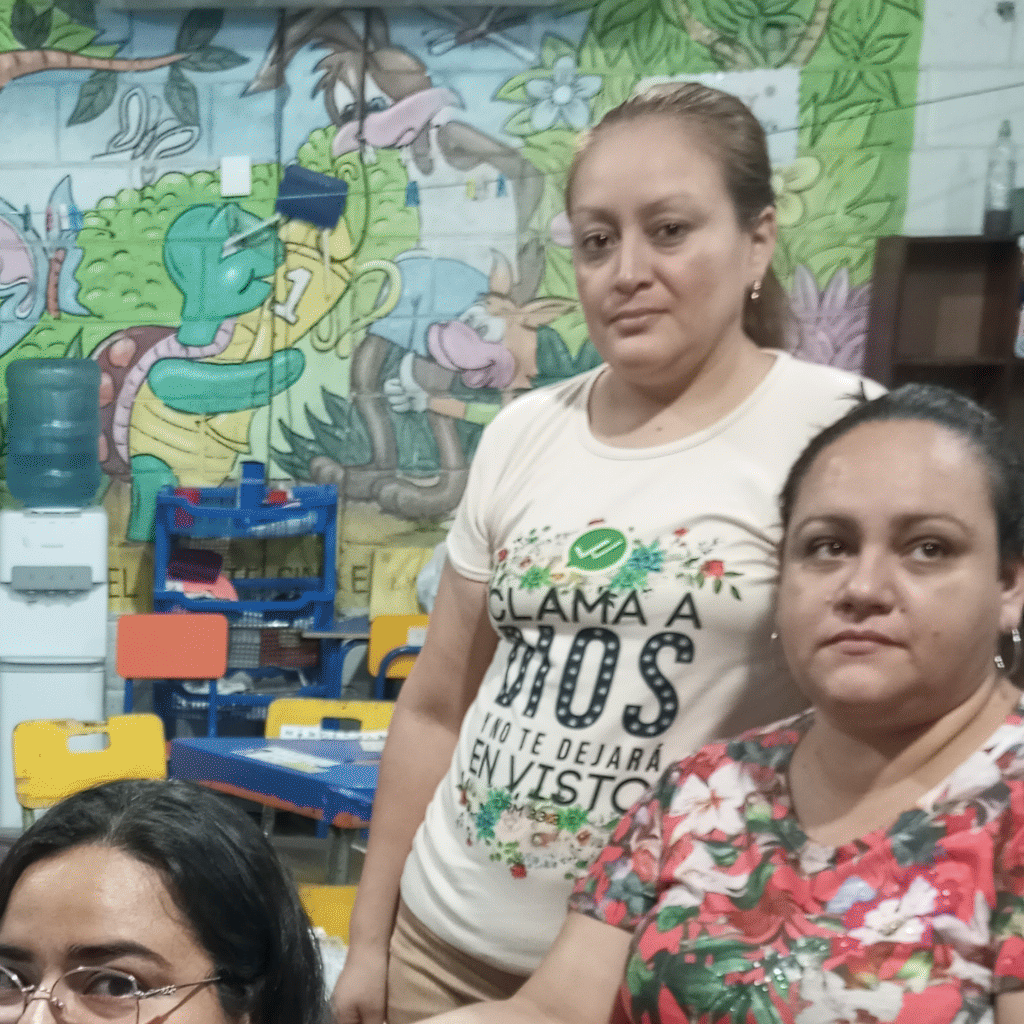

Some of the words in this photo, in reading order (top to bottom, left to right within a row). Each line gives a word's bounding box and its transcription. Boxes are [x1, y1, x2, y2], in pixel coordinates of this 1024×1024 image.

[489, 587, 647, 626] CLAMA
[664, 592, 703, 630] A
[494, 625, 696, 738] DIOS
[469, 738, 501, 788] EN
[489, 717, 512, 744] NO
[519, 728, 546, 755] TE
[556, 738, 665, 773] DEJARÁ
